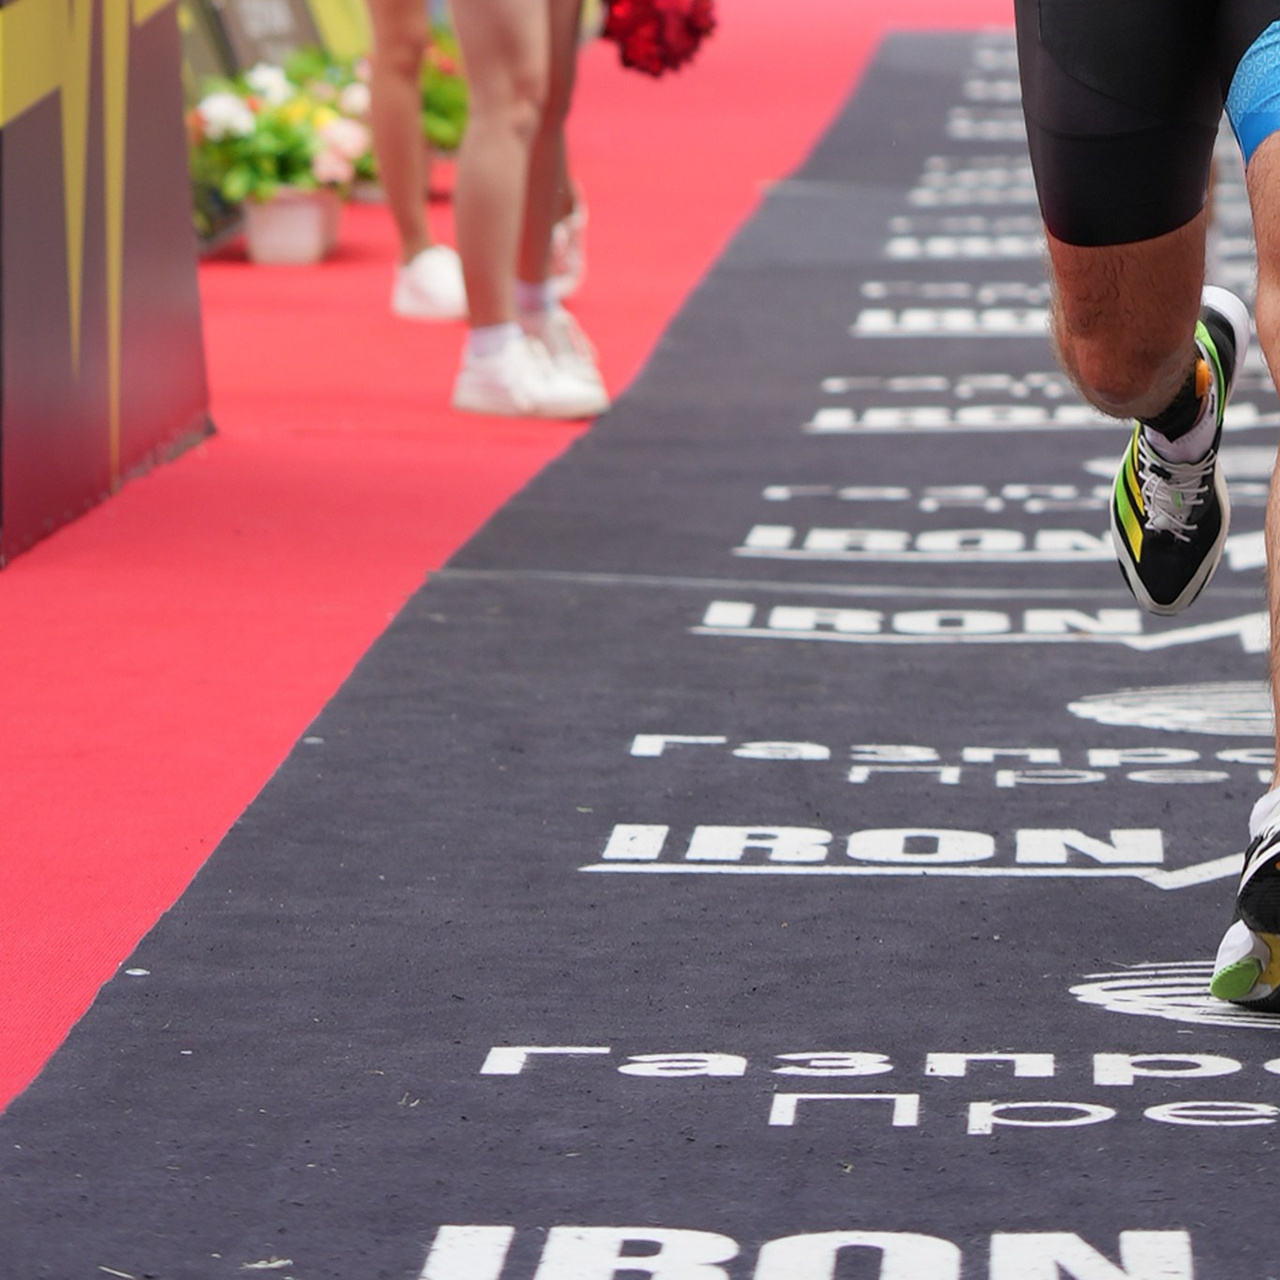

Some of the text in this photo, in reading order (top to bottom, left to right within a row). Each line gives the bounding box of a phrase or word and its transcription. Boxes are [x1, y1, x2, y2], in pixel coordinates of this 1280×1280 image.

[703, 600, 1142, 634] IRON
[602, 823, 1165, 864] IRON
[415, 1224, 1195, 1280] IRON
